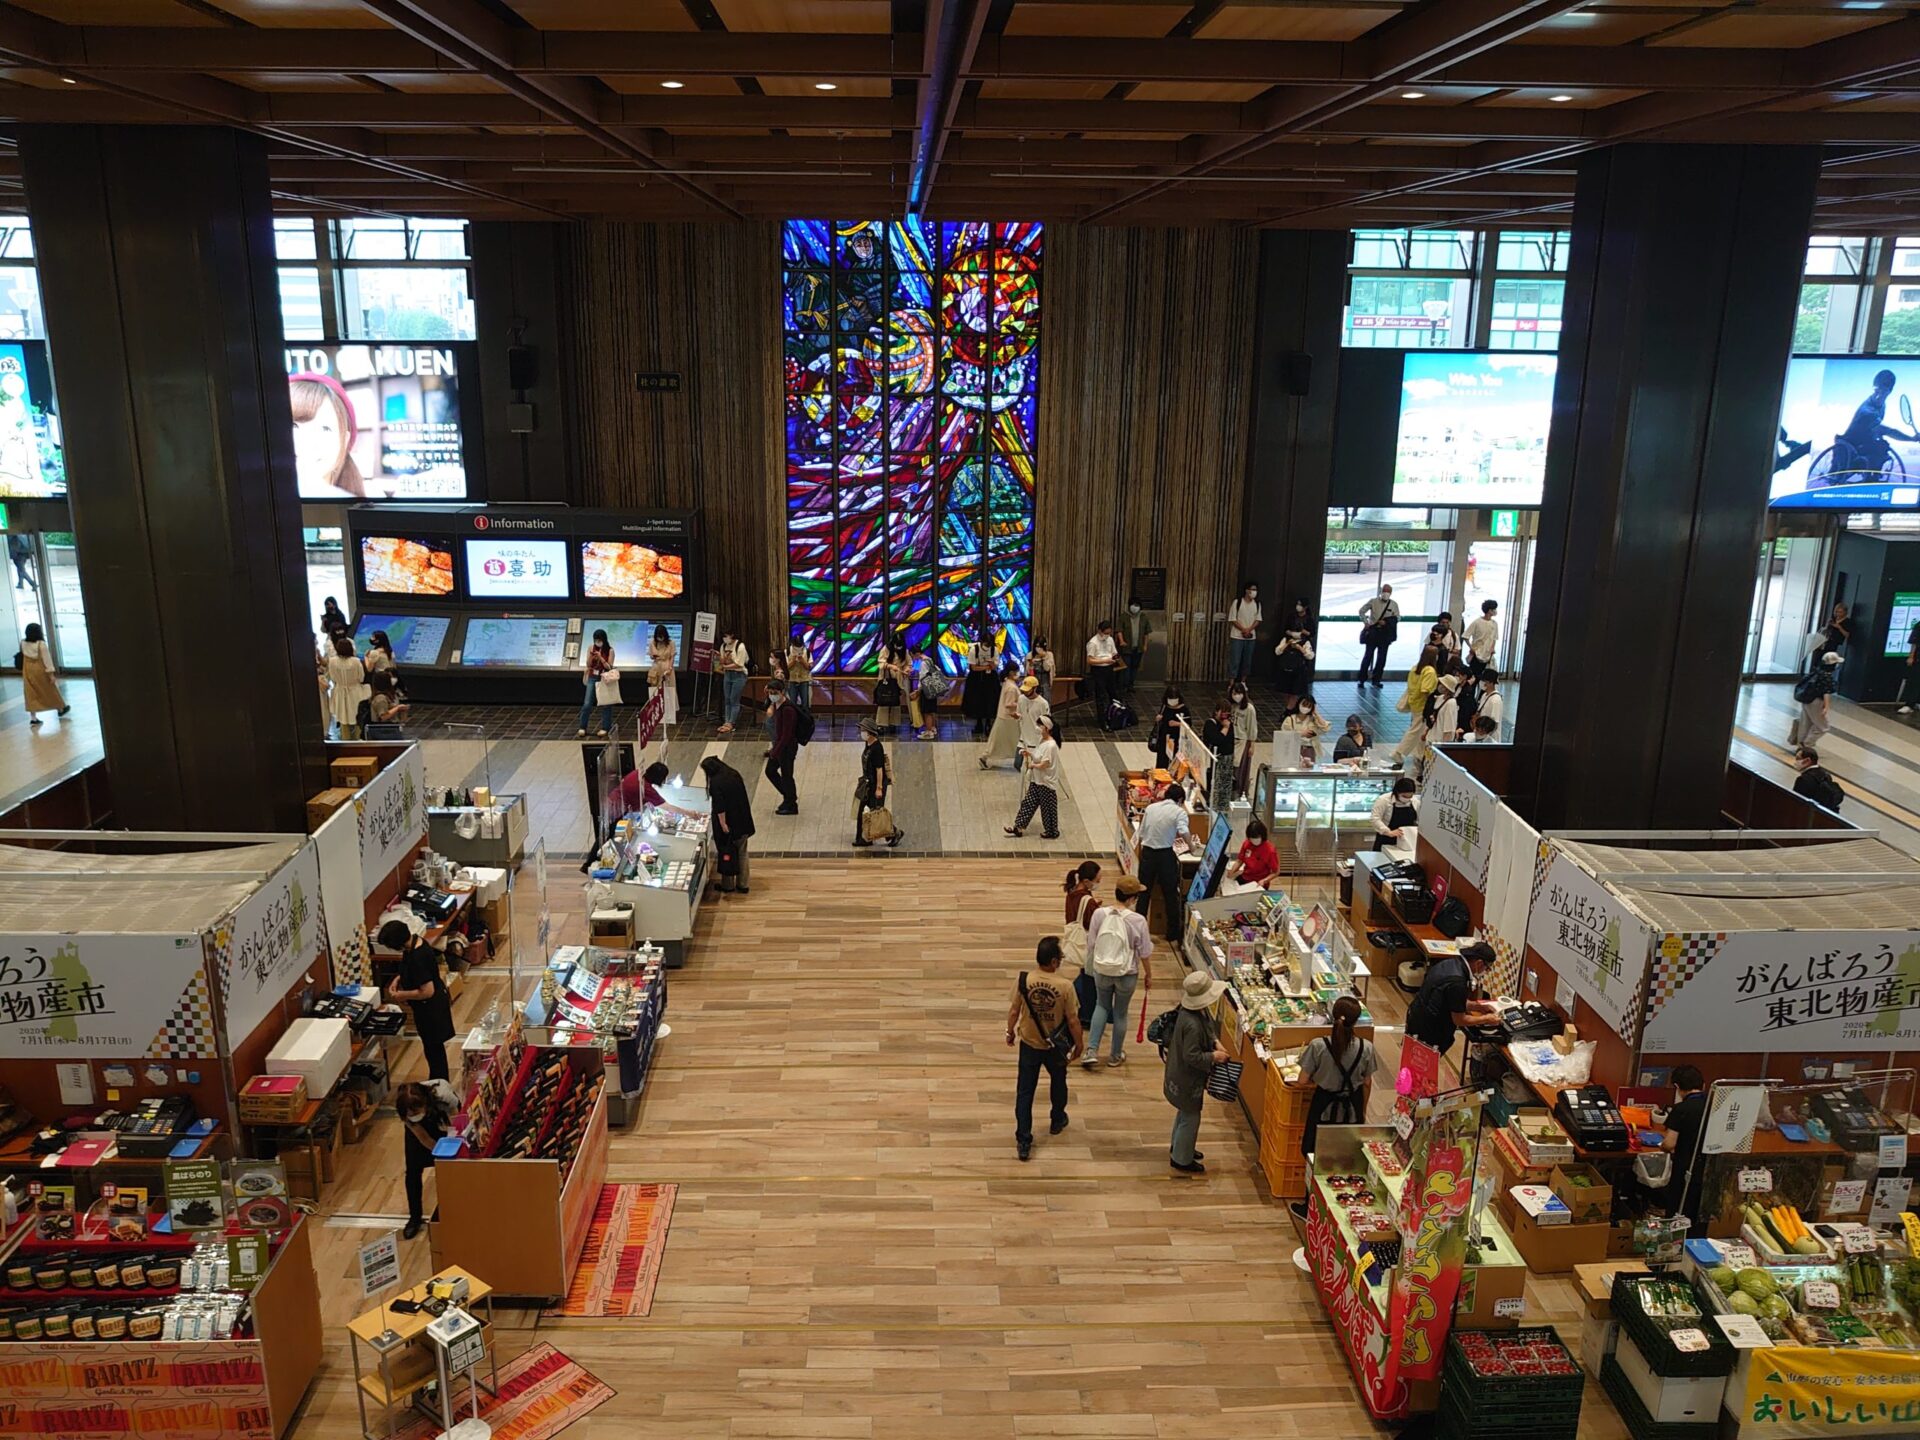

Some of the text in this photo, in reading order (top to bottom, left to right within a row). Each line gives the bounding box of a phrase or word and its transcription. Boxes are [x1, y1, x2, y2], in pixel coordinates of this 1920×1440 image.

[490, 518, 554, 529] Information
[1432, 779, 1470, 811] がんばろう
[1550, 884, 1607, 932] がんばろう
[239, 885, 292, 971] がんばろう
[1558, 920, 1625, 977] 東北物産市
[1736, 944, 1895, 994] がんばろう
[19, 1027, 49, 1036] 2020年
[1843, 1022, 1872, 1030] 2020年
[1725, 1102, 1741, 1132] 山形県
[83, 1357, 159, 1389] BARATZ
[182, 1356, 257, 1387] BARATZ
[42, 1403, 118, 1433] BARATZ
[140, 1402, 214, 1432] BARATZ
